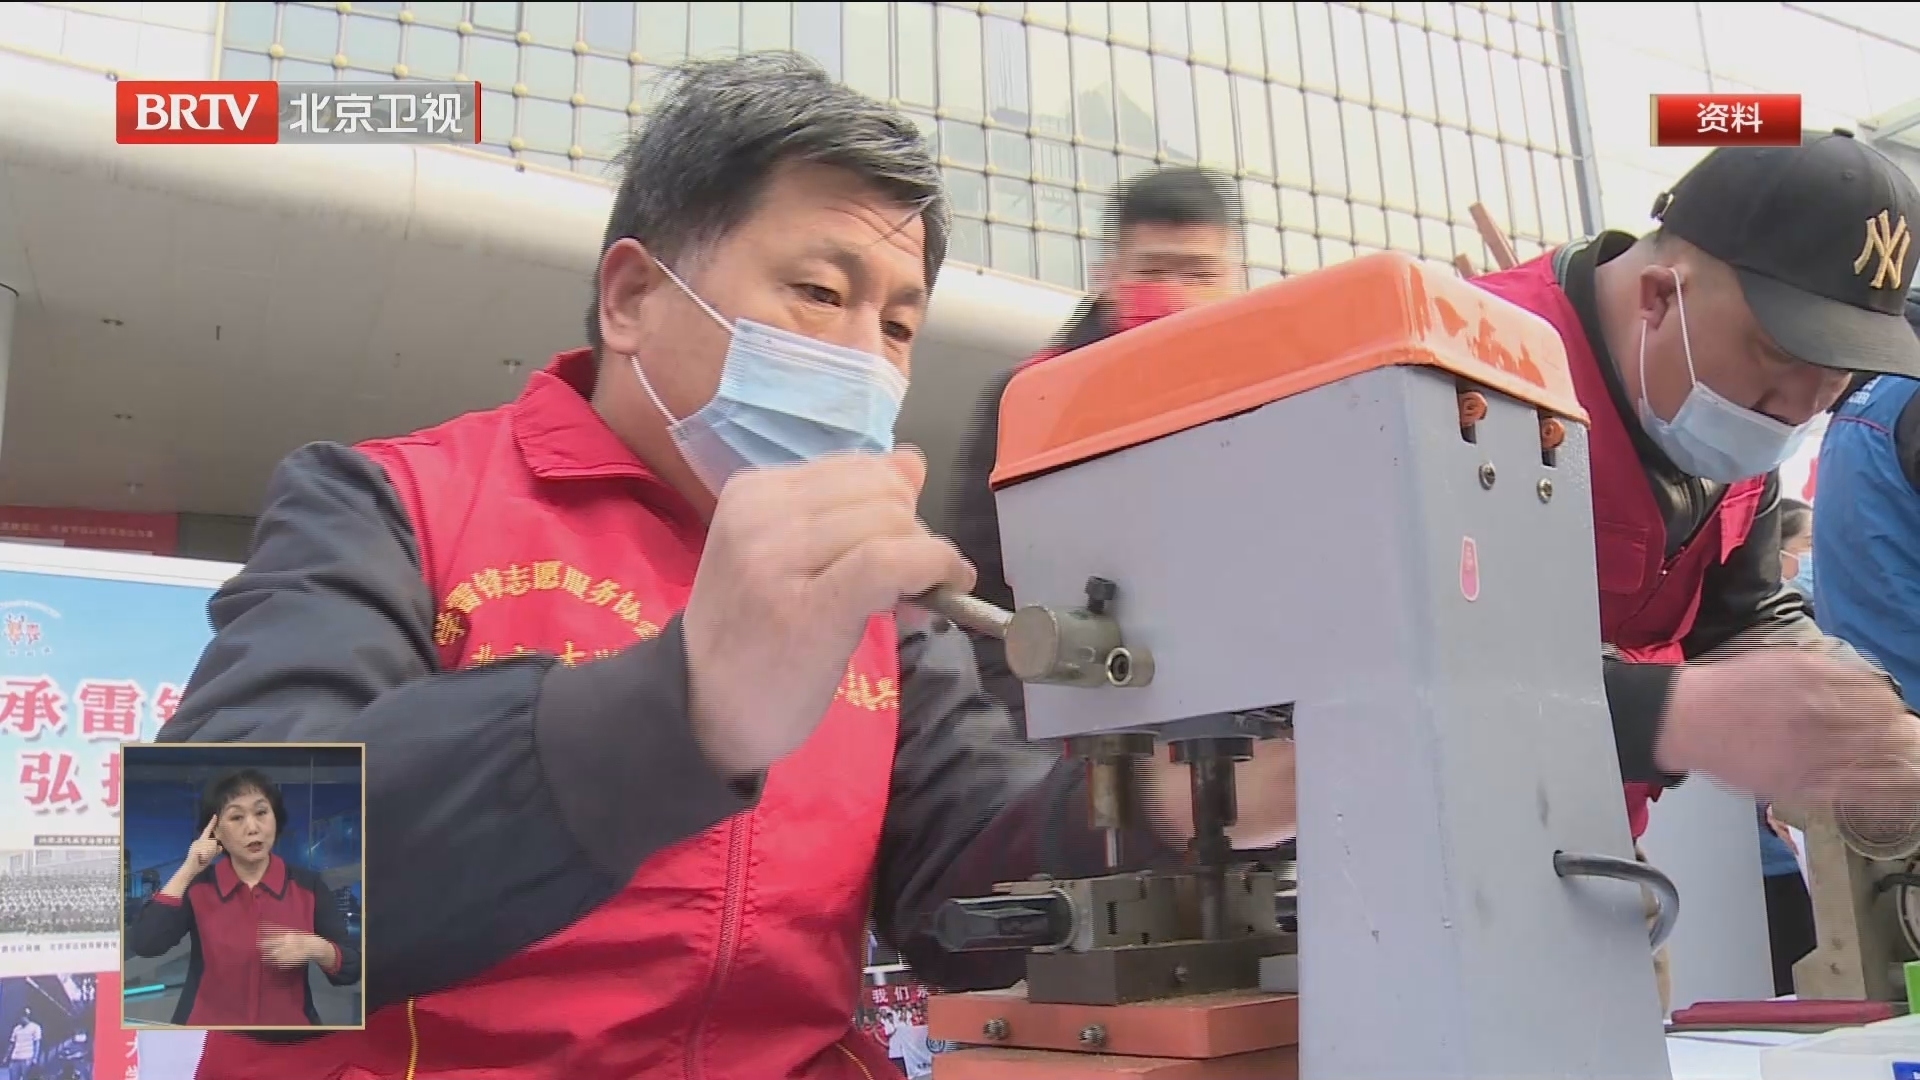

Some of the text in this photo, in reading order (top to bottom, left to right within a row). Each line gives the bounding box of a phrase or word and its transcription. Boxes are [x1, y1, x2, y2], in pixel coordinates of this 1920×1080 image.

[434, 559, 663, 646] 学雷锋志愿服务协会
